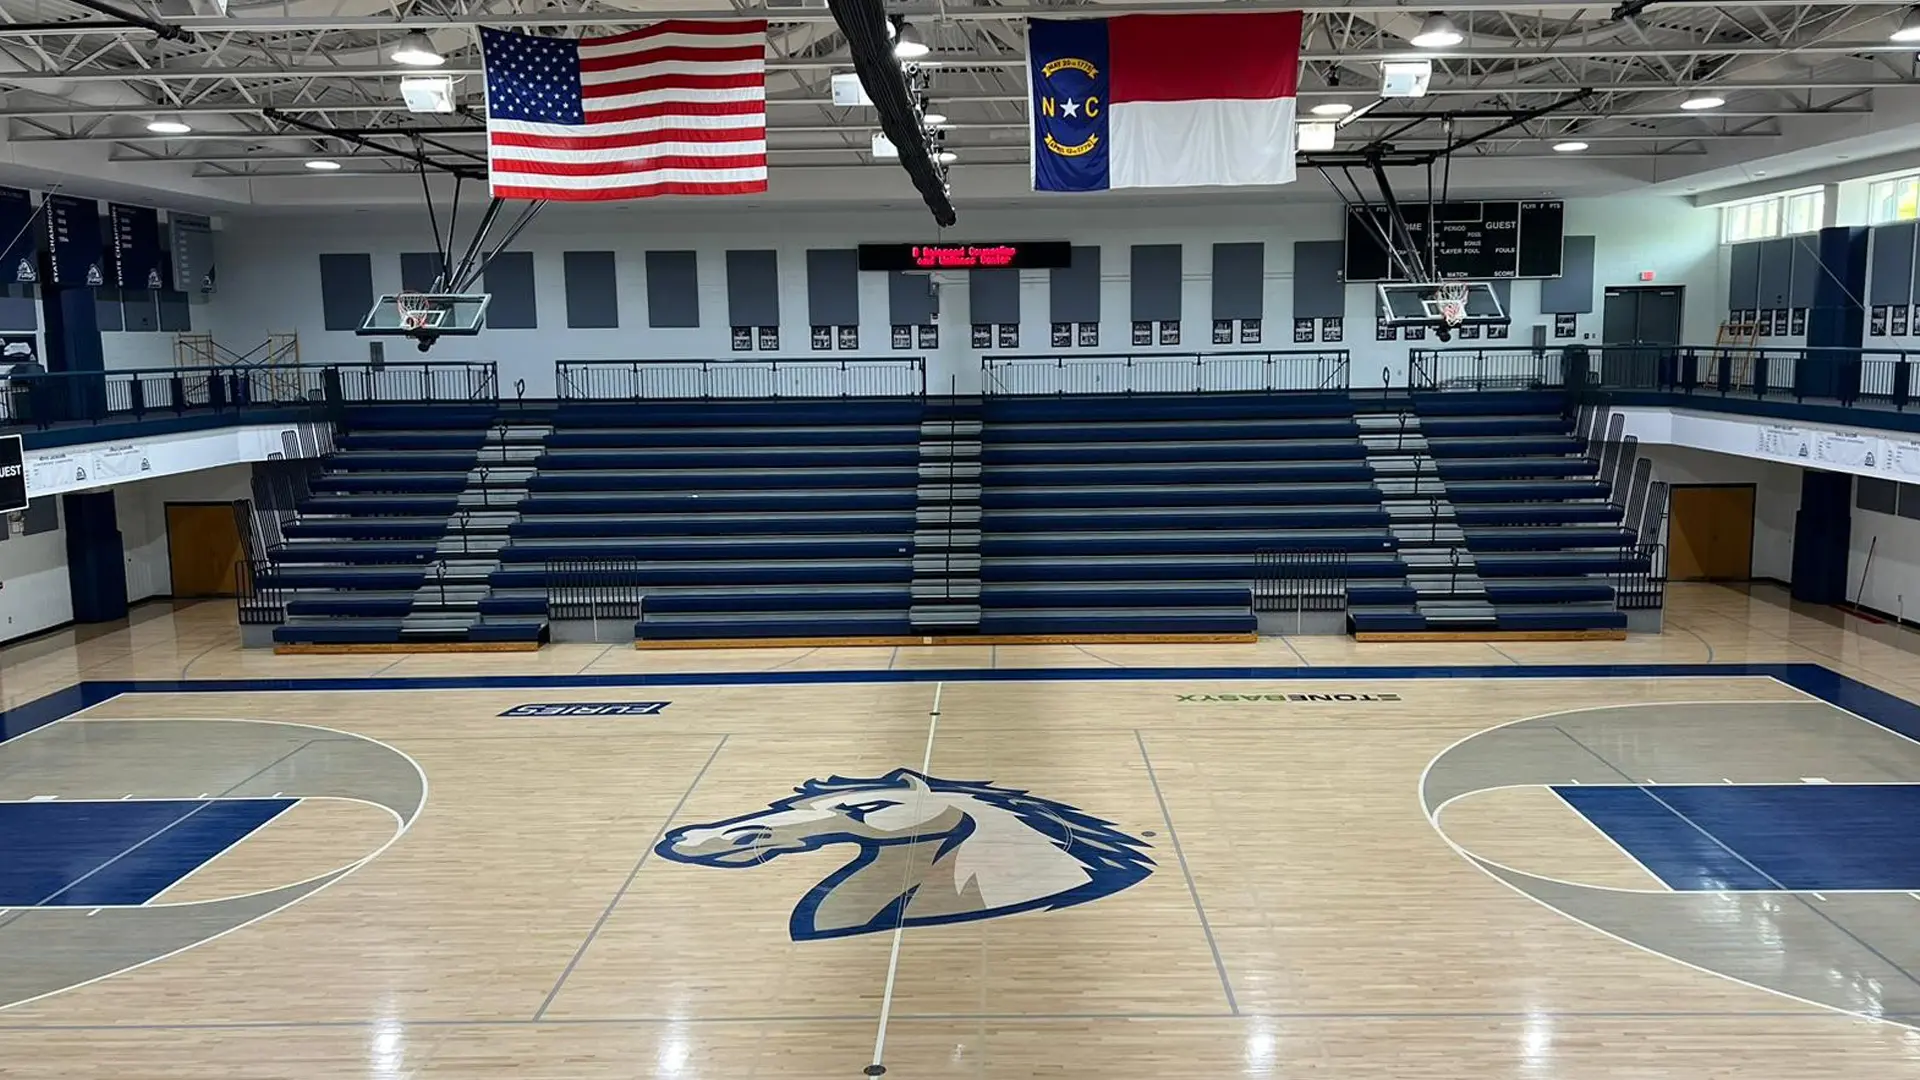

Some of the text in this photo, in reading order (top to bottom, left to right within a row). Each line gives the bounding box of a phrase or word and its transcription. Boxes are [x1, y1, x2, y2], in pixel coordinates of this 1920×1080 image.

[1047, 61, 1061, 71] MAY
[1042, 96, 1099, 117] N C
[1485, 221, 1516, 230] GUEST
[1463, 247, 1481, 255] FOUL
[51, 255, 60, 283] STATE
[115, 260, 124, 287] STATE
[508, 704, 660, 715] FURIES
